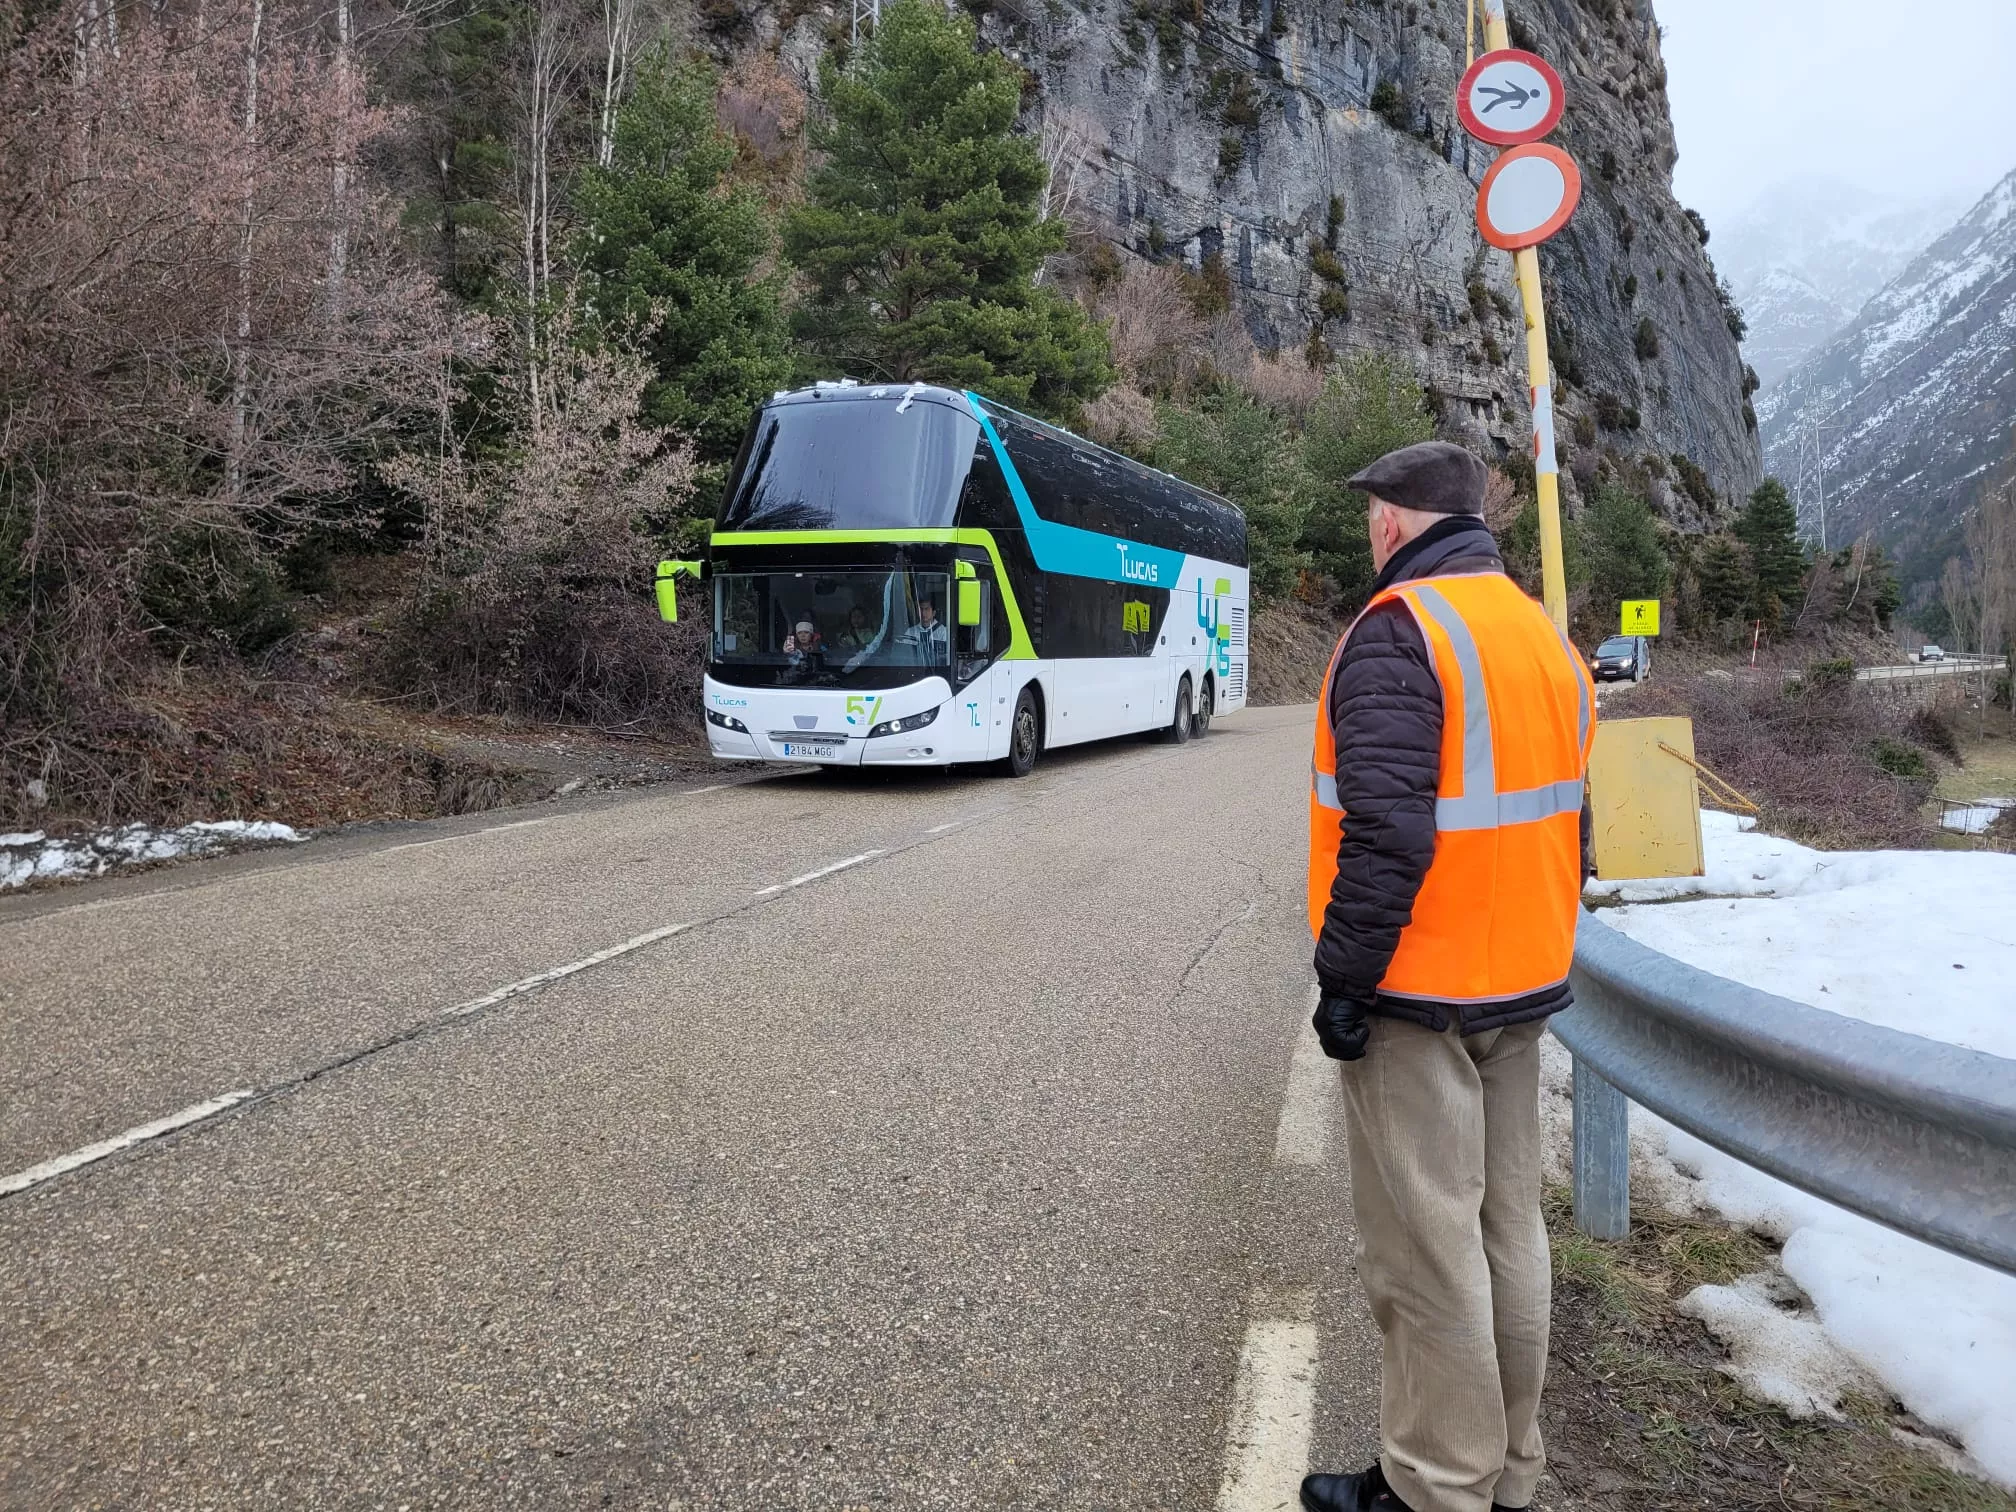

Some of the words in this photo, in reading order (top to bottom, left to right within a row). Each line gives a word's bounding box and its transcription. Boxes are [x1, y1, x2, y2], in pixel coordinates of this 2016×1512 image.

[846, 695, 883, 725] 57
[790, 745, 812, 756] 2184
[814, 747, 832, 757] MGG
